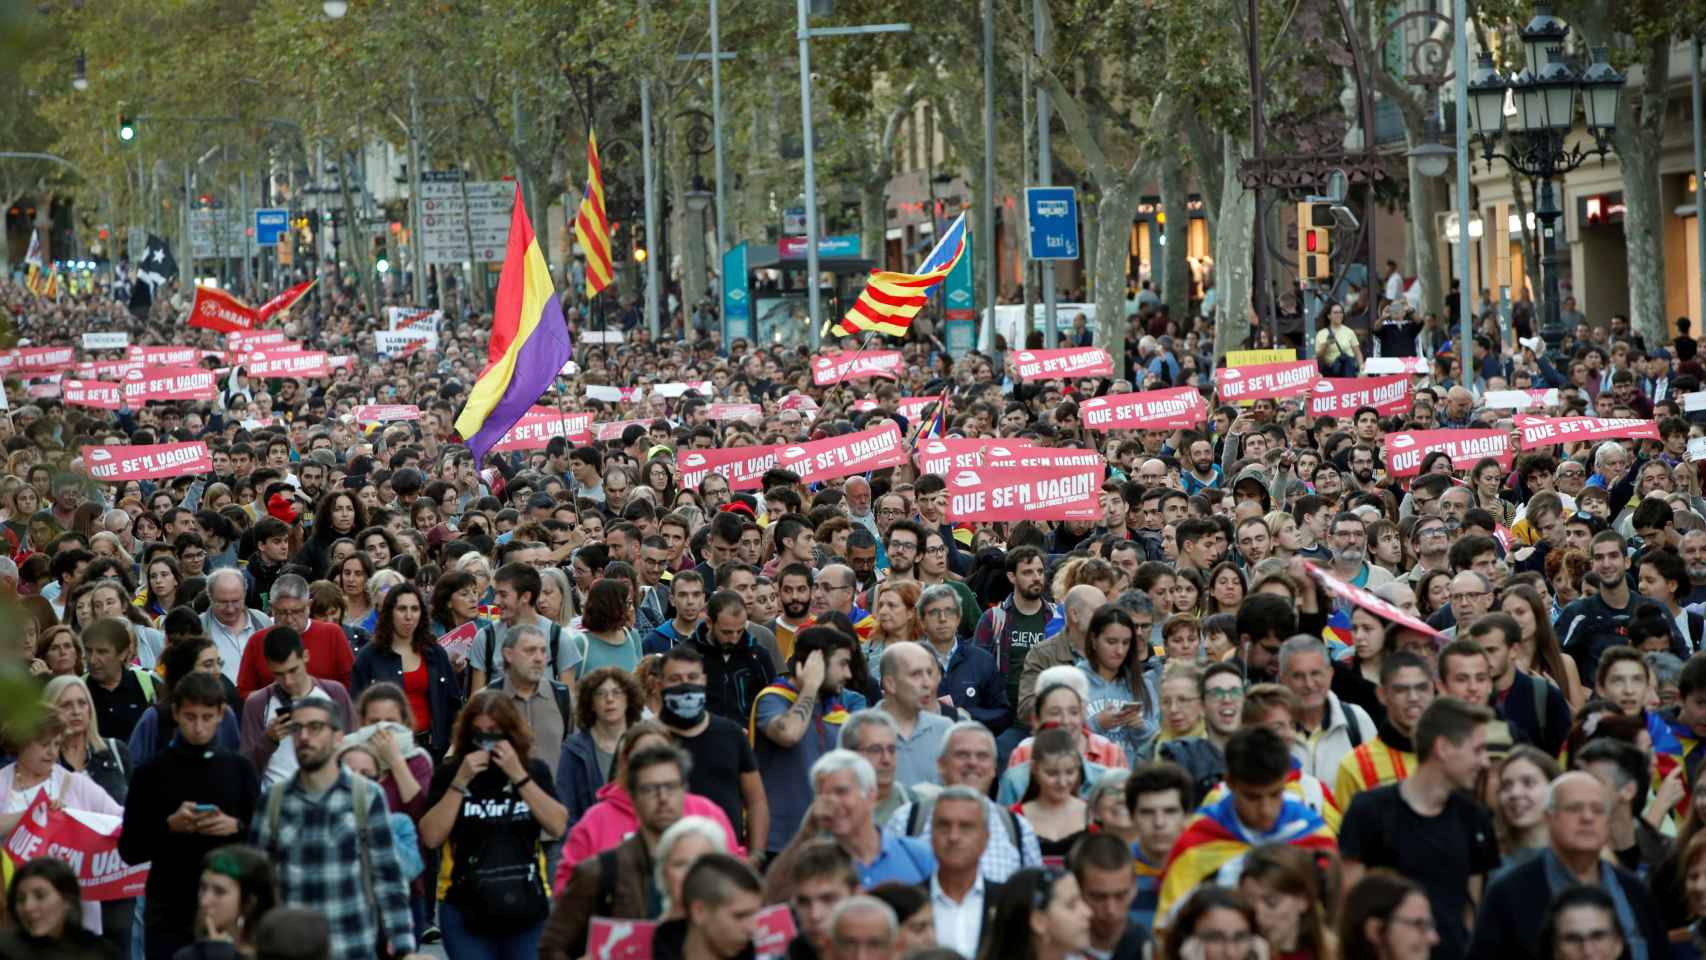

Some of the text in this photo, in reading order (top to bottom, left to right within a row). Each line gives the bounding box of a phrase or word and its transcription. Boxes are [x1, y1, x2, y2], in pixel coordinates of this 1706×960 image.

[1046, 233, 1064, 248] taxi
[817, 368, 837, 382] QUE
[1020, 362, 1042, 377] QUE
[1043, 355, 1068, 372] SE'N
[1071, 351, 1105, 368] VAGIN!
[126, 381, 147, 396] QUE
[176, 373, 213, 388] VAGIN!
[1223, 365, 1315, 397] QUE SE'N VAGIN!
[67, 390, 85, 401] QUE
[1313, 379, 1408, 412] QUE SE'N VAGIN!
[1088, 408, 1113, 425] QUE
[1115, 402, 1144, 419] SE'N
[515, 423, 543, 441] SE'N
[546, 415, 589, 435] VAGIN!
[1525, 423, 1556, 442] QUE
[1559, 419, 1594, 434] SE'N
[785, 457, 814, 478] QUE
[816, 445, 849, 470] SE'N
[851, 429, 898, 456] VAGIN!
[1392, 449, 1421, 471] QUE
[1461, 434, 1508, 455] VAGIN!
[952, 472, 1095, 515] QUE SE'N VAGIN!
